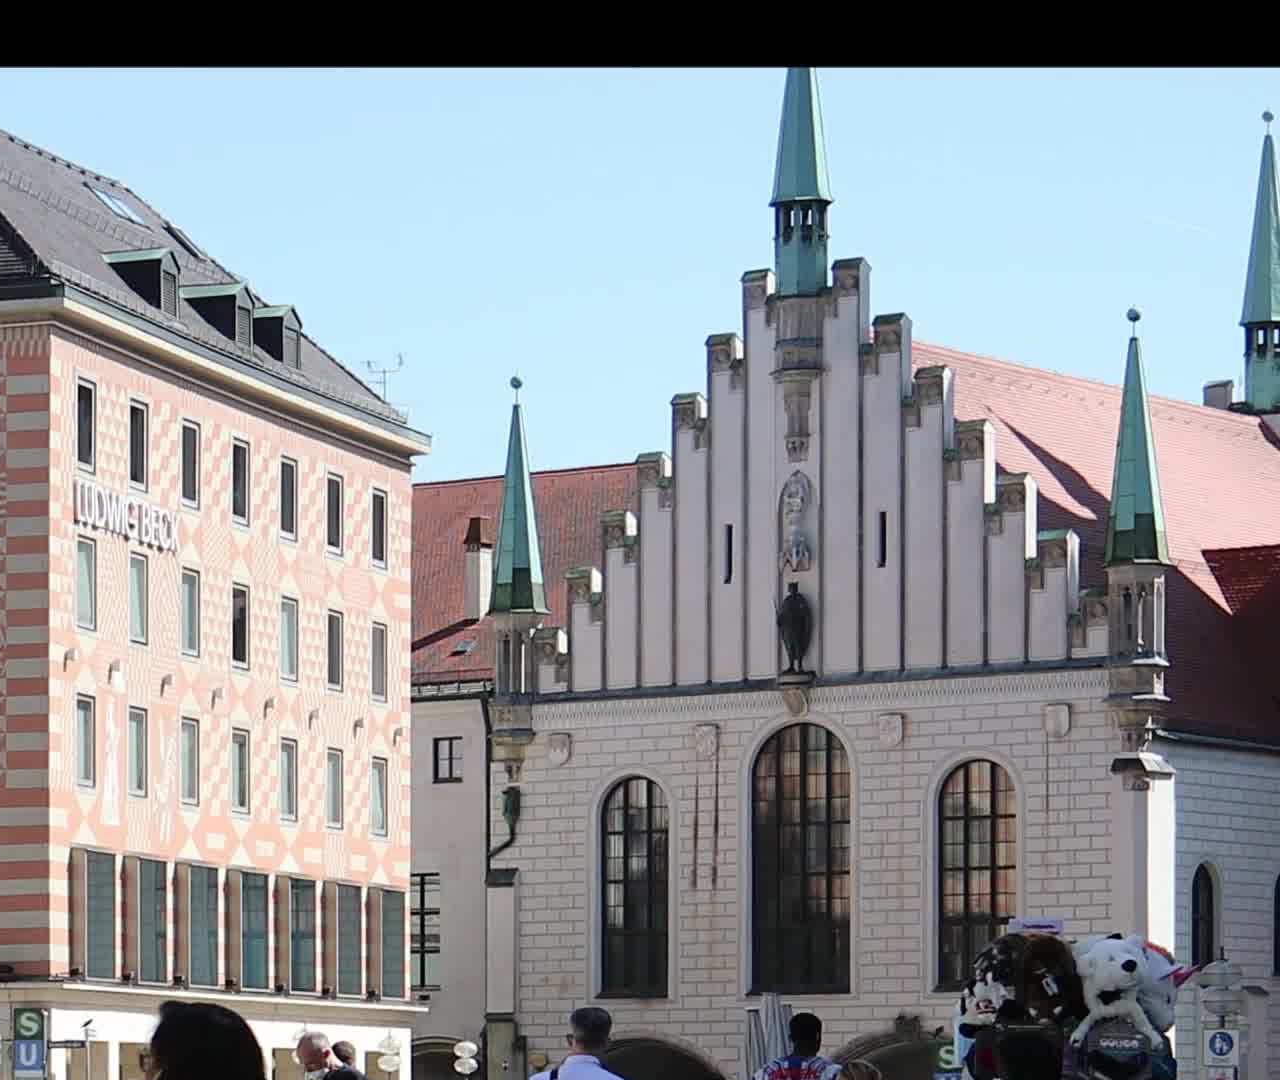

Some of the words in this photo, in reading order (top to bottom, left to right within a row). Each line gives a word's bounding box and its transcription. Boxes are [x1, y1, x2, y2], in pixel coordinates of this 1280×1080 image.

[74, 478, 139, 541] LUDWIG
[141, 498, 178, 552] BECK
[20, 1012, 40, 1036] S
[20, 1043, 37, 1066] U
[939, 1045, 959, 1069] S
